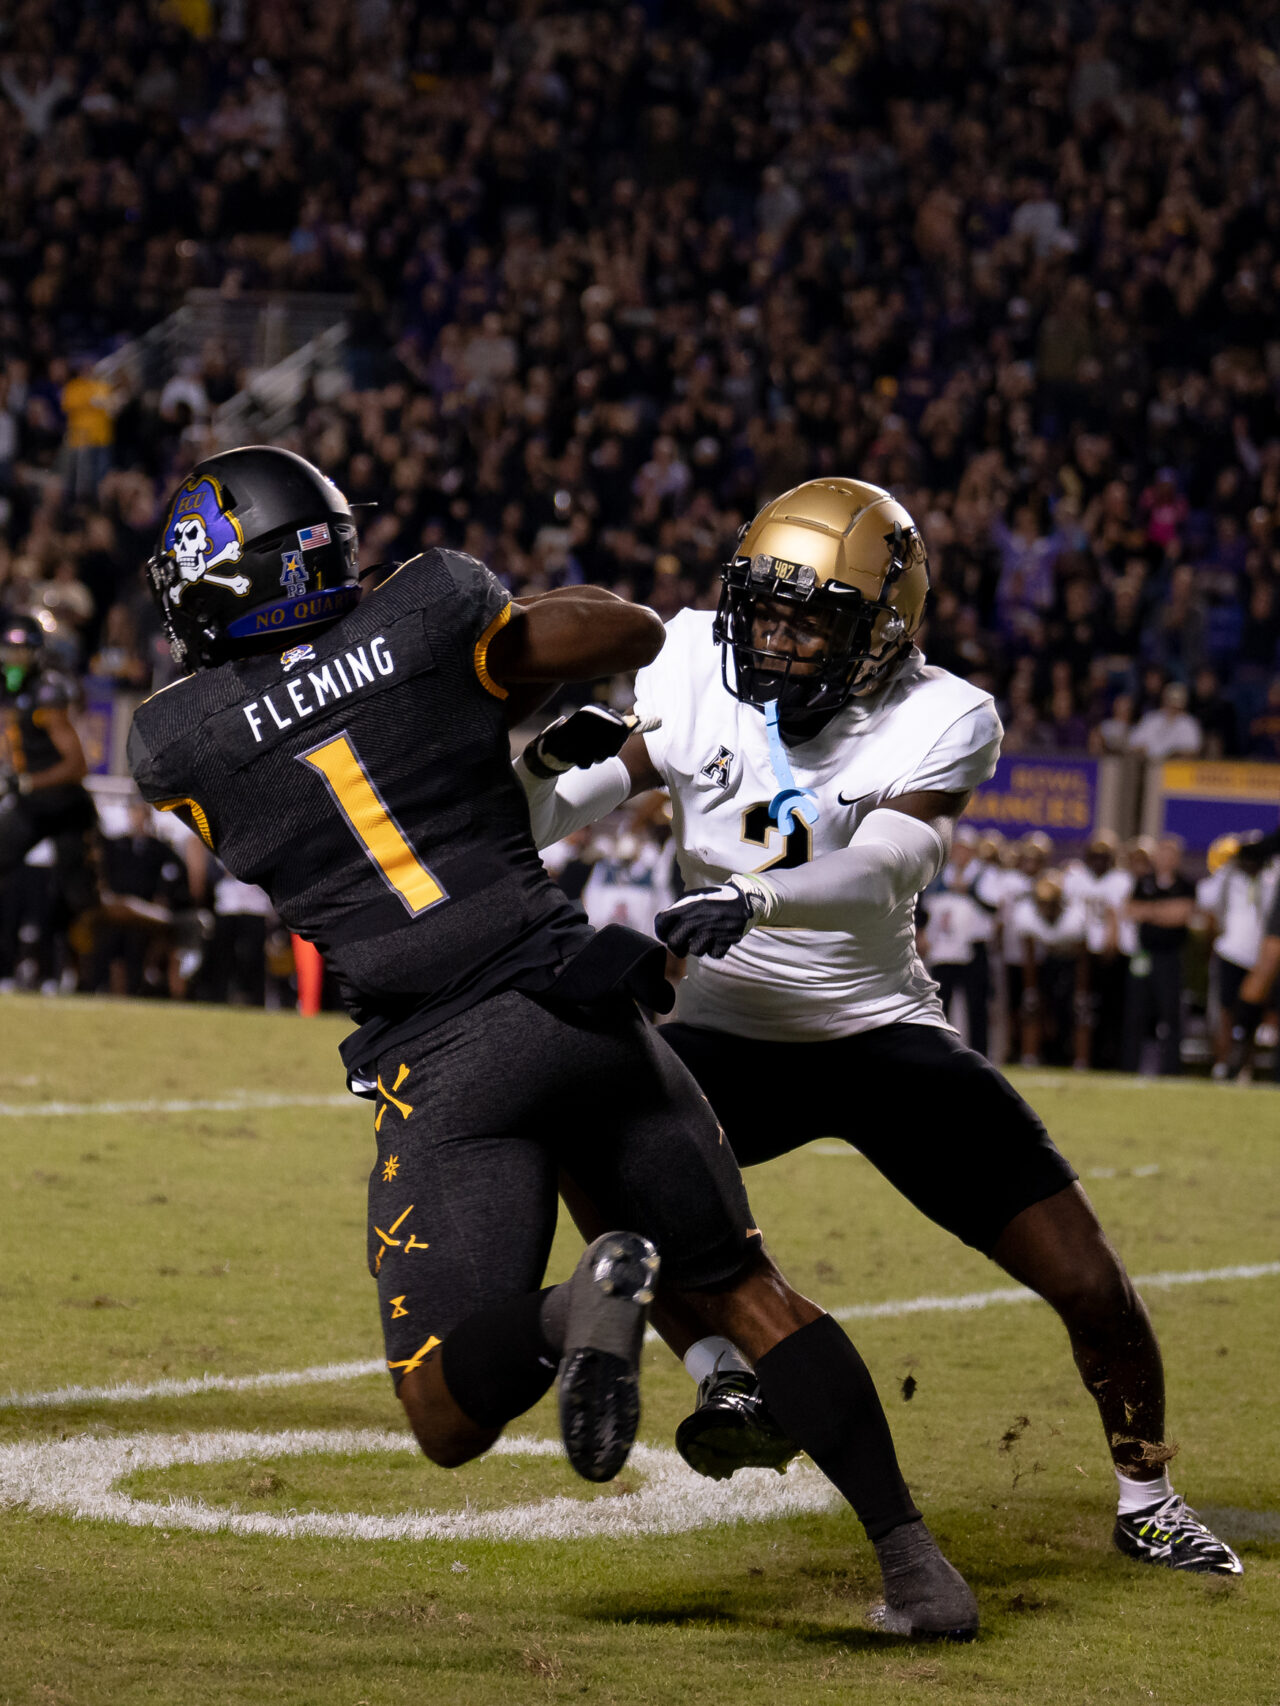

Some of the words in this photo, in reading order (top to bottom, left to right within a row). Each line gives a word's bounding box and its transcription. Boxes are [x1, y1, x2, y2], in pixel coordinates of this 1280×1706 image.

[177, 491, 207, 514] ECU
[774, 560, 795, 579] 407
[255, 608, 286, 630] NO
[243, 636, 395, 742] FLEMING
[294, 729, 450, 919] 1
